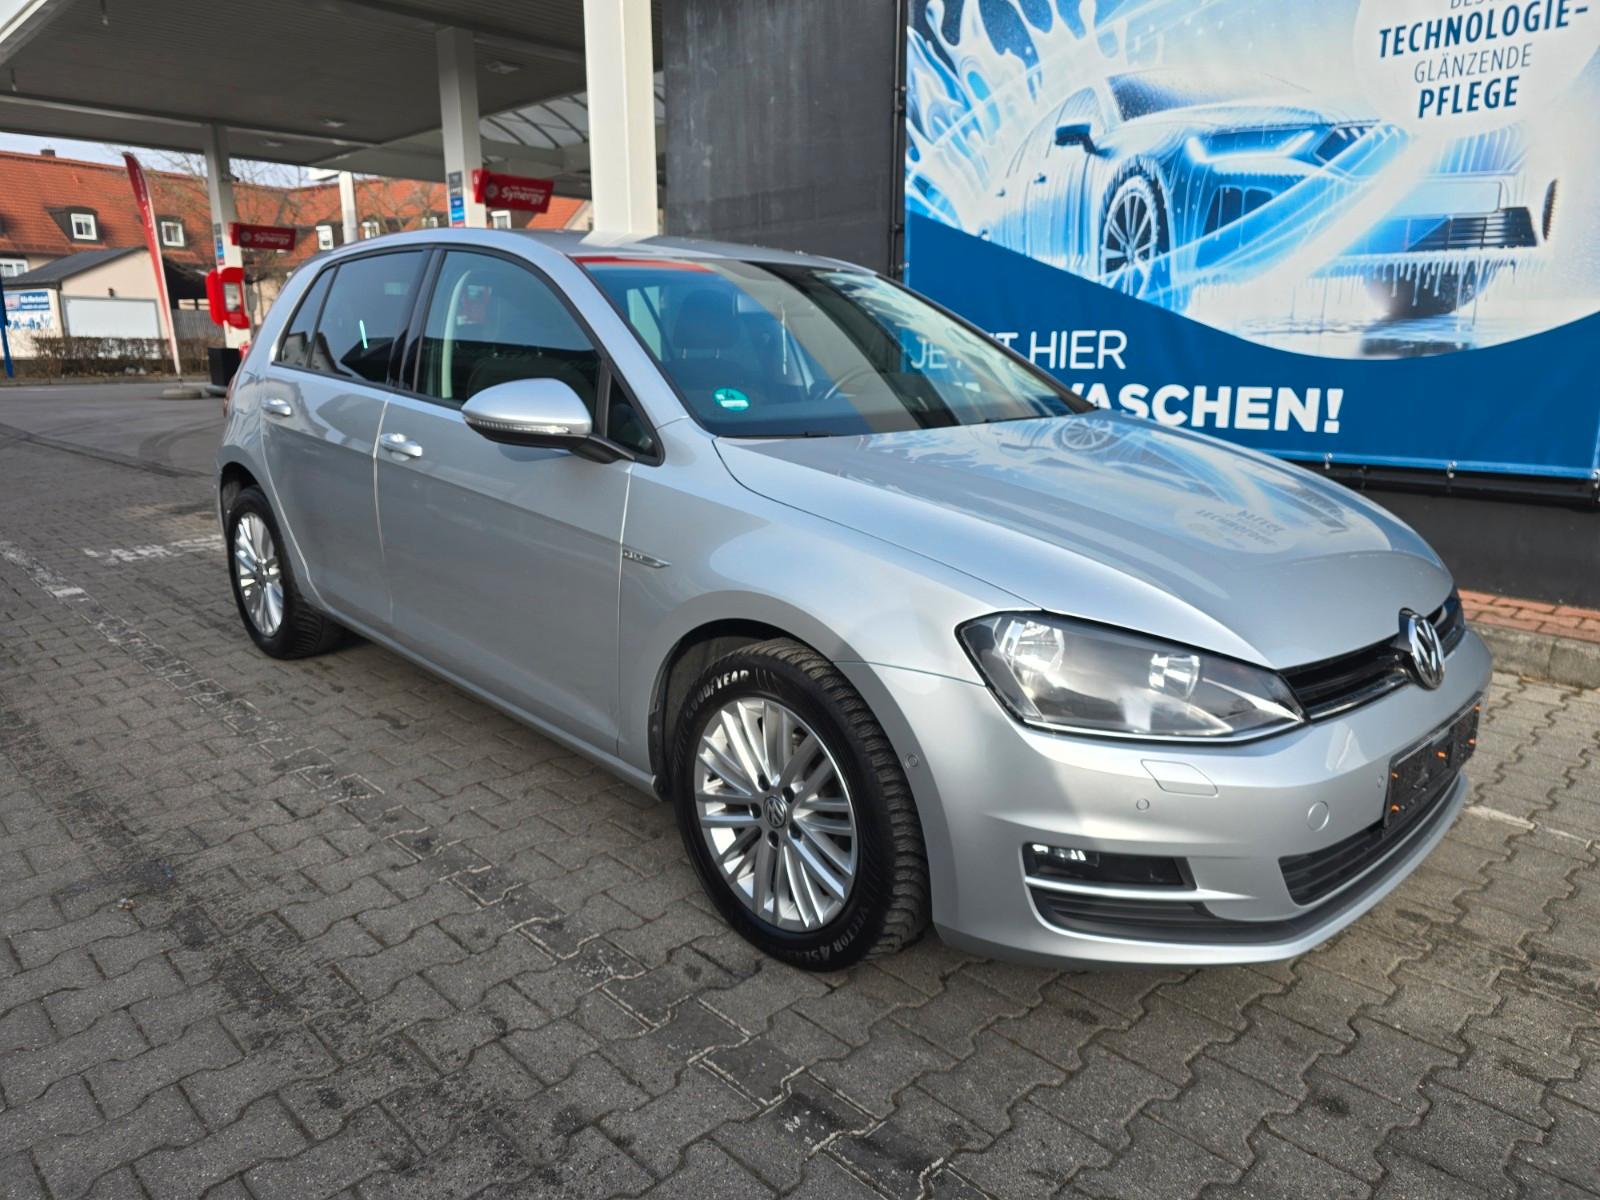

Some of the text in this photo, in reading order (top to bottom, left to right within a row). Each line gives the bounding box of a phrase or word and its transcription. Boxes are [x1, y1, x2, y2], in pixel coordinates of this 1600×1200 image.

[1379, 0, 1588, 58] TECHNOLOGIE-
[1414, 43, 1533, 83] GLÄNZENDE
[1418, 75, 1520, 119] PFLEGE
[1029, 329, 1128, 370] HIER
